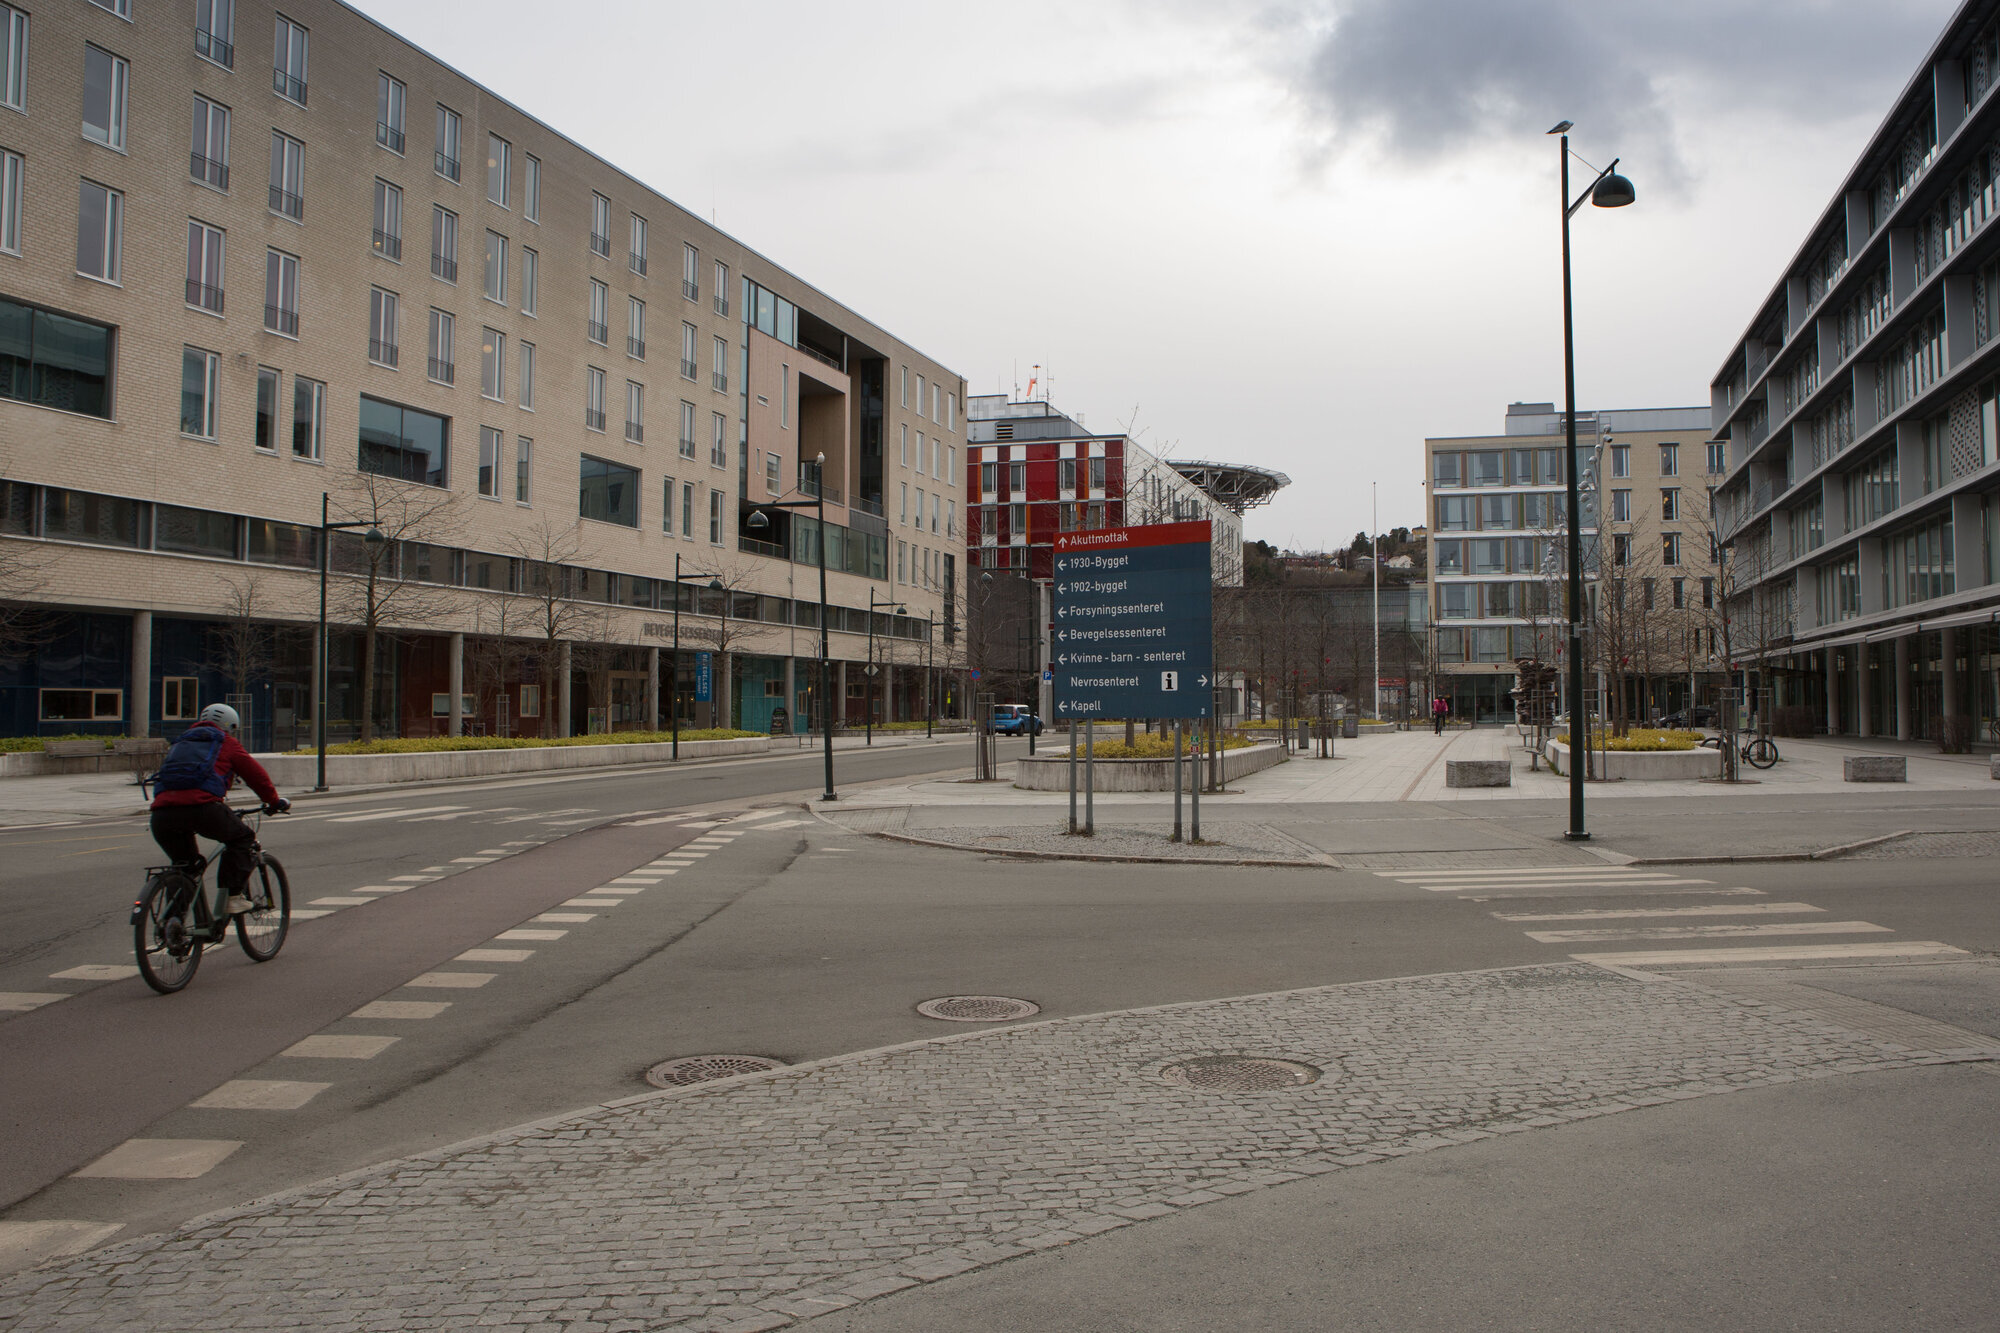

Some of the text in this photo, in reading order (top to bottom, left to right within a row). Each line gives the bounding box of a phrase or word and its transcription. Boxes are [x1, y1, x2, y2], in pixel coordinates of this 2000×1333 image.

[1070, 530, 1129, 546] Akuttmottak
[1070, 555, 1129, 569] 1930-Bygget
[1070, 580, 1127, 593] 1902-bygget
[1070, 602, 1164, 617] Forsyningssenteret
[1070, 627, 1166, 642] Bevegelsessenteret
[1070, 653, 1102, 664] Kvinne
[1111, 652, 1133, 663] barn
[1144, 651, 1186, 662] senteret
[1070, 676, 1139, 687] Nevrosenteret
[1070, 701, 1101, 714] Kapell
